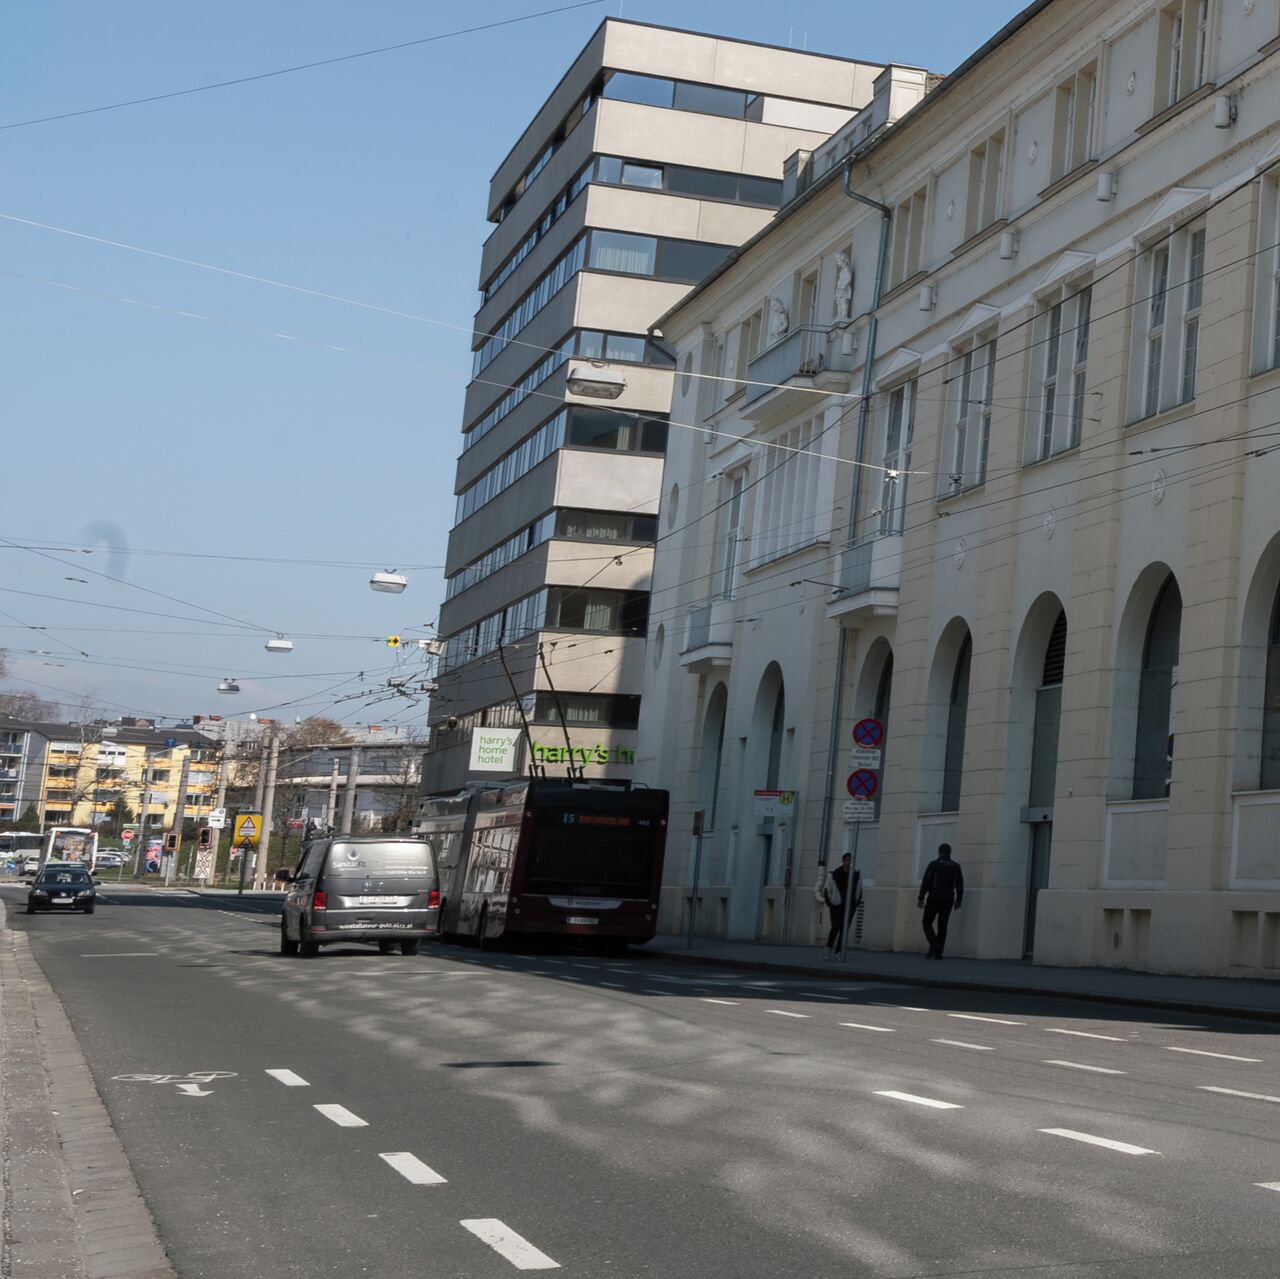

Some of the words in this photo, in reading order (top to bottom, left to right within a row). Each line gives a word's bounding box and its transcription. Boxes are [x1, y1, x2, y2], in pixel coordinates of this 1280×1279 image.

[480, 736, 514, 747] harry's
[479, 745, 508, 755] home
[532, 741, 610, 769] harry's
[477, 755, 504, 764] hotel
